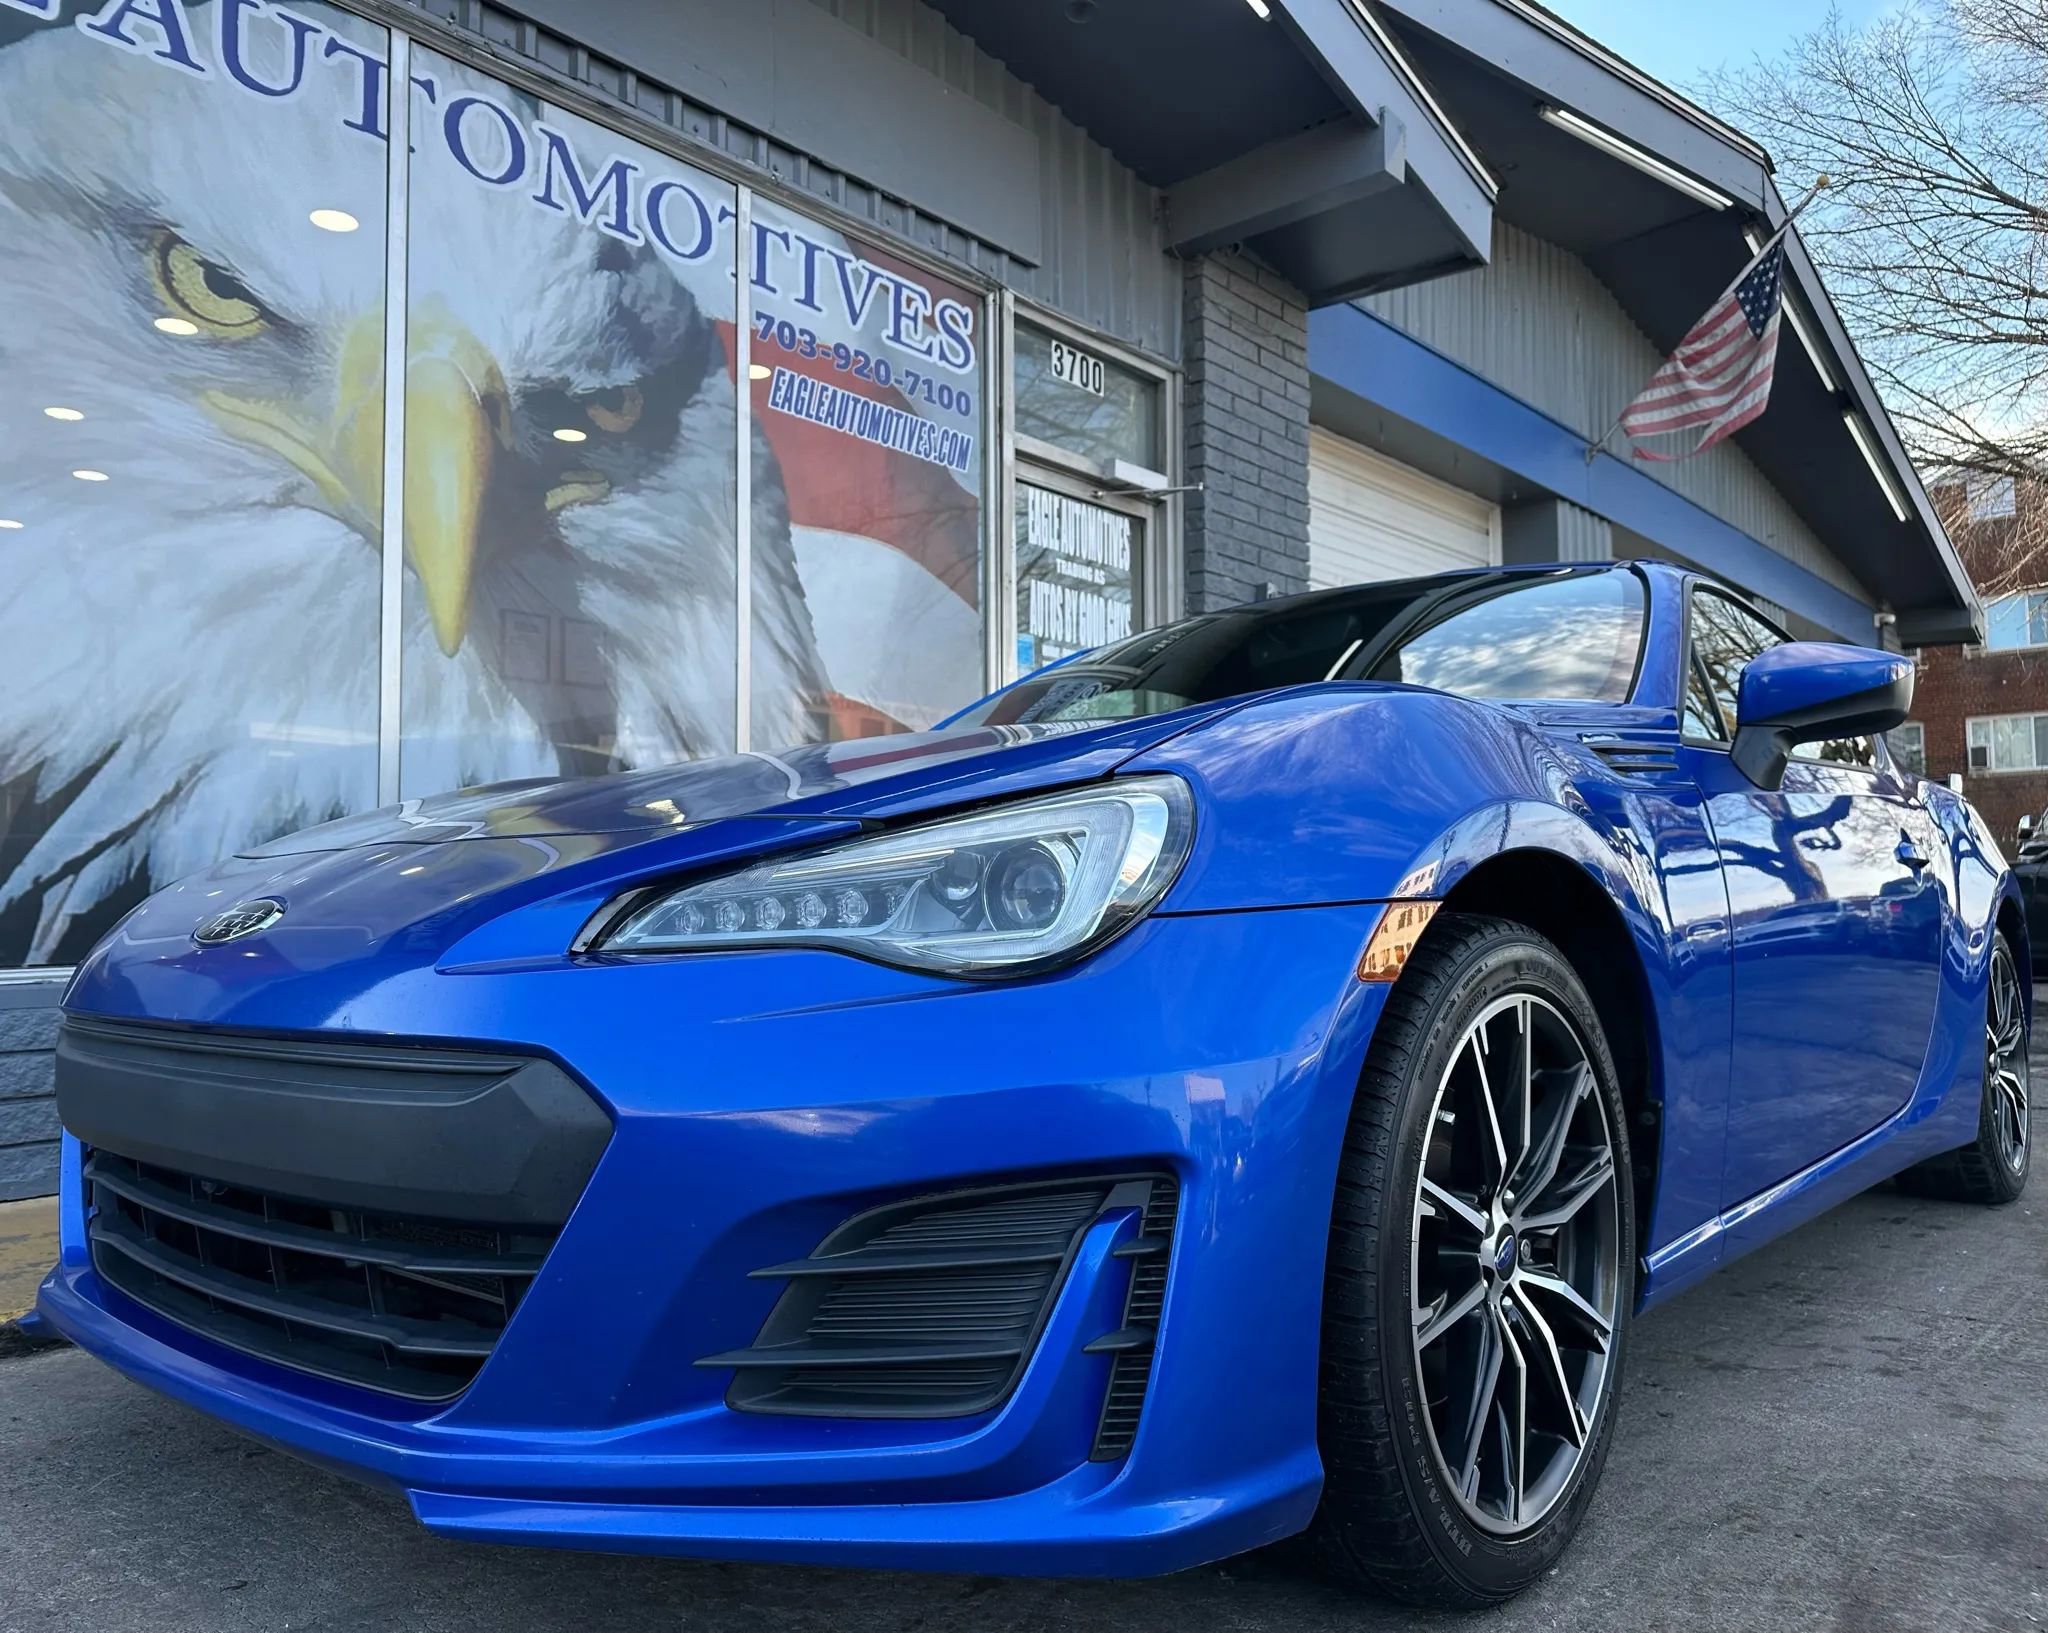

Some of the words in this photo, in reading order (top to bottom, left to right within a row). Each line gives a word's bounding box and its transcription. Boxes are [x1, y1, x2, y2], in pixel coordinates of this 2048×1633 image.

[85, 0, 973, 370] AUTOMOTIVES
[755, 310, 971, 417] 703-920-7100
[1054, 343, 1101, 394] 3700
[770, 368, 972, 472] EAGLEAUTOMOTIVES.COM
[1028, 487, 1061, 552] EAGLE
[1061, 498, 1131, 572] AUTOMOTIVES
[1056, 558, 1093, 582] TRADING
[1094, 569, 1106, 585] AS
[1029, 578, 1064, 642] AUTOS
